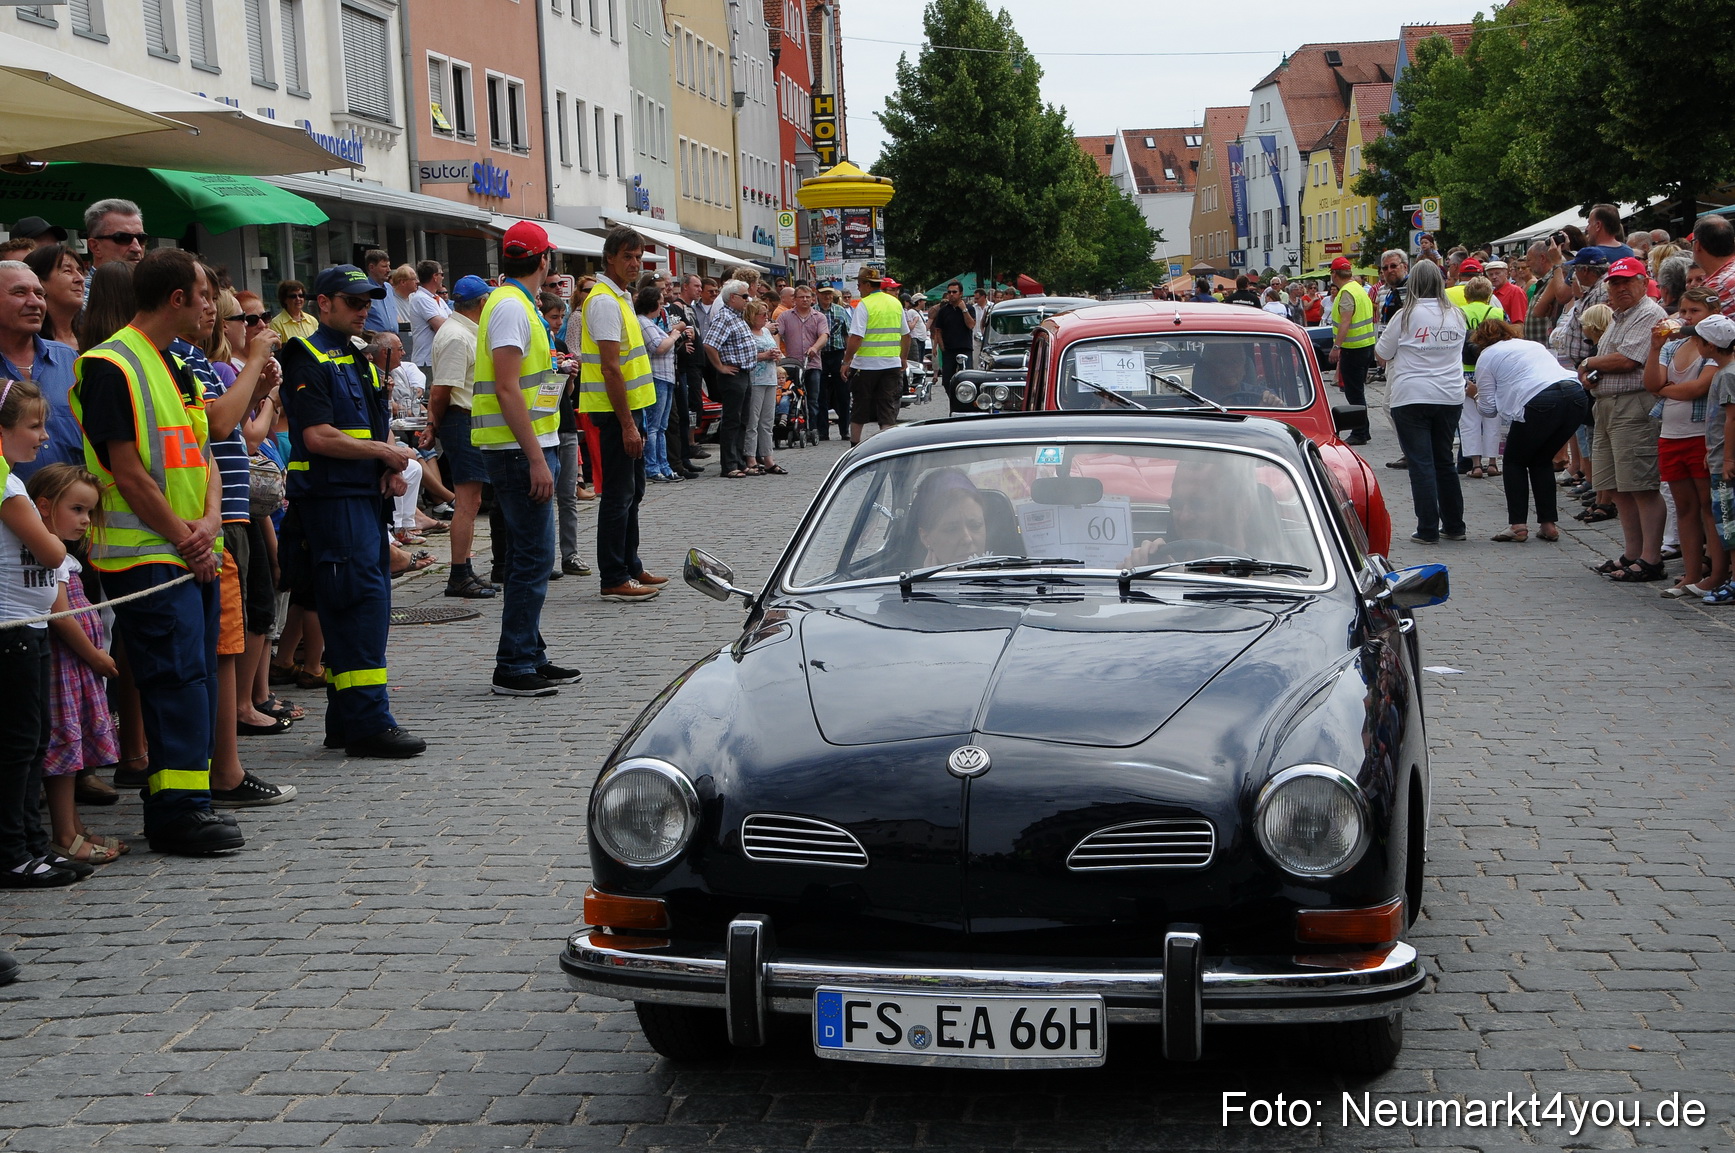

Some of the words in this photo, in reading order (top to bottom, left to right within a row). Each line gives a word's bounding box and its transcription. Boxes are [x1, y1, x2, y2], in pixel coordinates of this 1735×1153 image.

[1116, 358, 1135, 370] 46
[1087, 516, 1116, 541] 60
[825, 1025, 835, 1038] D
[845, 1001, 902, 1045] FS
[936, 1005, 995, 1049] EA
[1010, 1007, 1098, 1050] 66H
